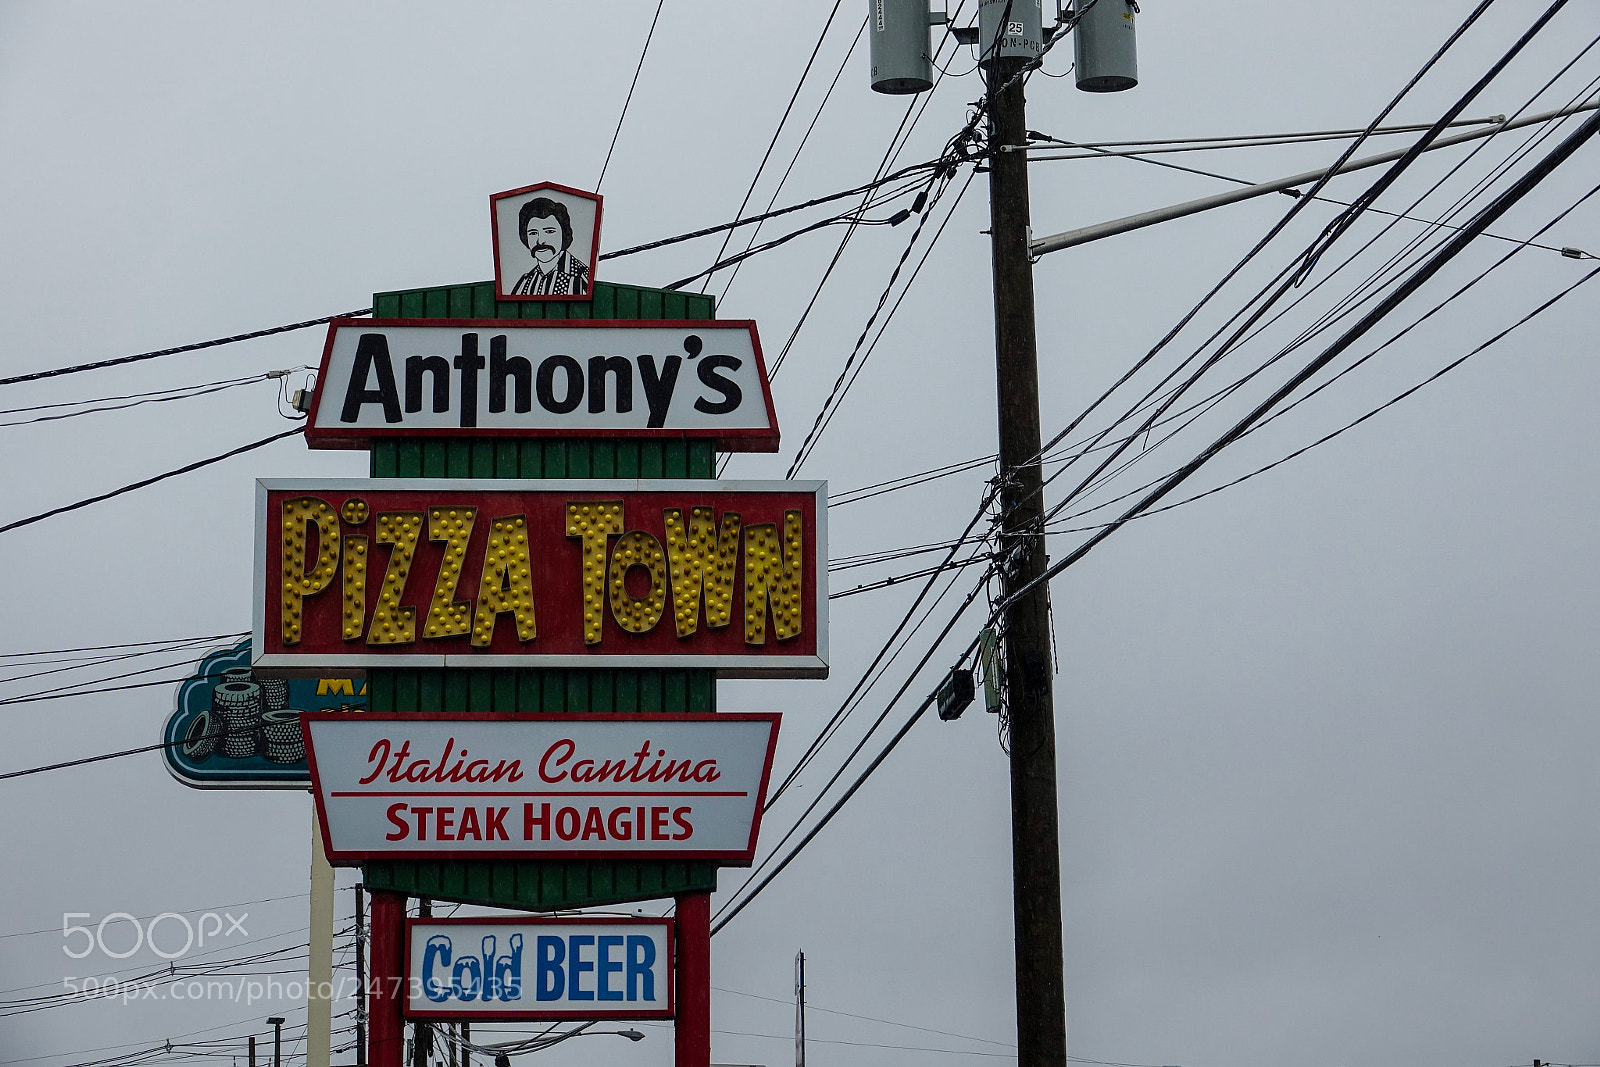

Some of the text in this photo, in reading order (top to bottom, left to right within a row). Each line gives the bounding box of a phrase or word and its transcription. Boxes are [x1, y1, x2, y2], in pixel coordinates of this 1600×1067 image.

[1000, 37, 1040, 52] ON-PCB
[1009, 23, 1022, 33] 25
[340, 332, 743, 429] Anthony's
[358, 737, 722, 785] Italian Cantina
[385, 802, 694, 842] STEAK HOAGIES
[422, 932, 657, 1003] Cold BEER
